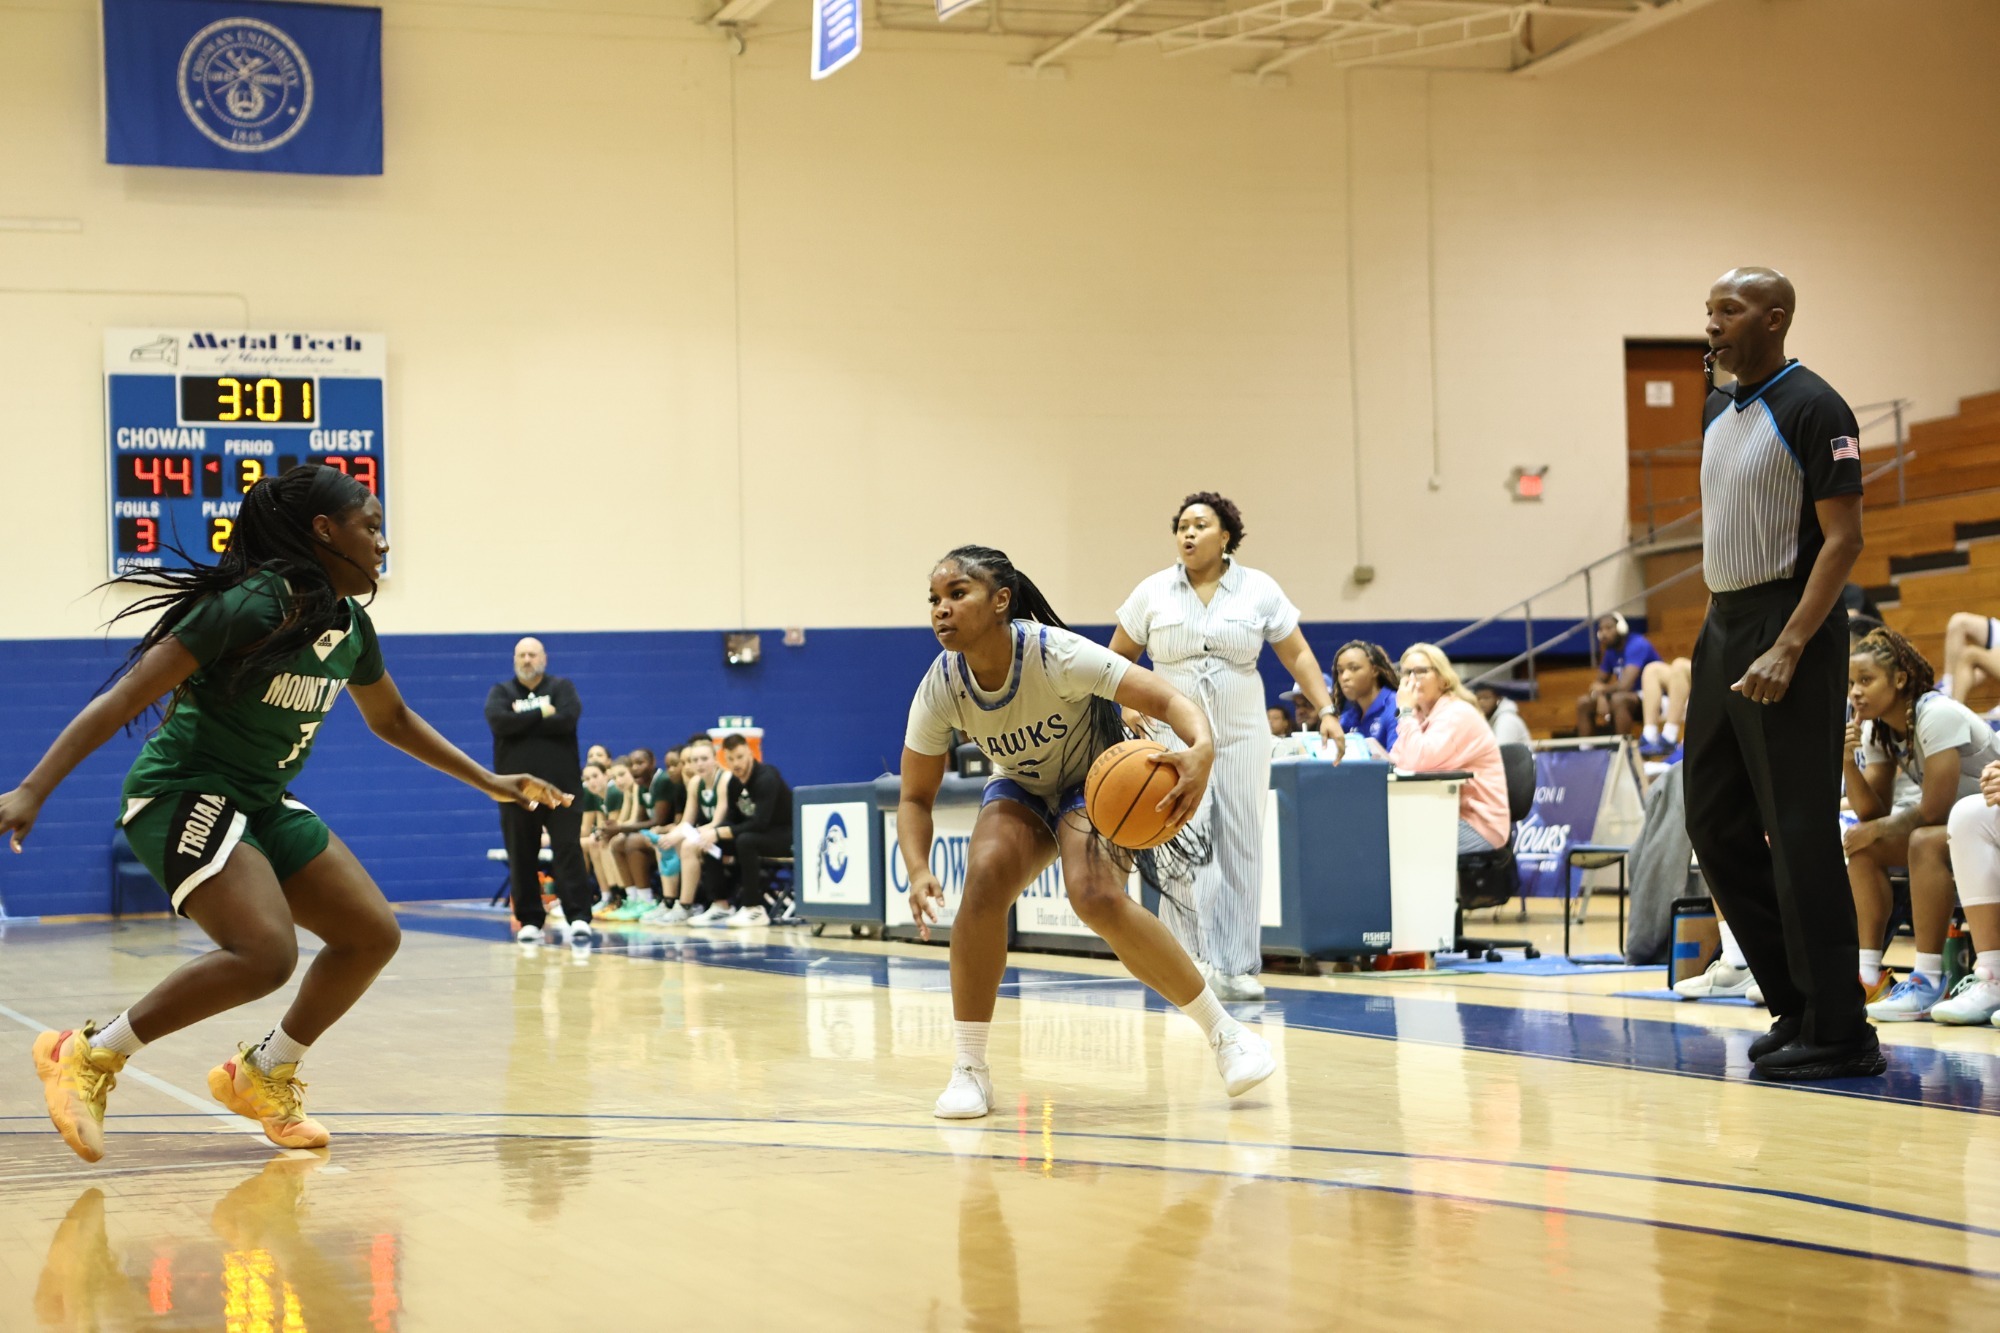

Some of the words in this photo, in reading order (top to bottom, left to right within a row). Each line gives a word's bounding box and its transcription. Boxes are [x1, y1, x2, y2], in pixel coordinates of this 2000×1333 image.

[187, 331, 277, 351] Metal
[284, 332, 363, 352] Tech
[217, 377, 312, 422] 3:01
[116, 427, 206, 450] CHOWAN
[224, 439, 274, 456] PERIOD
[309, 429, 374, 451] GUEST
[134, 457, 192, 495] 44
[241, 459, 263, 494] 3
[115, 501, 160, 518] FOULS
[136, 518, 158, 553] 3
[261, 672, 328, 712] MOUNT
[1036, 907, 1059, 926] Home
[1059, 906, 1068, 926] of
[1363, 931, 1391, 943] FISHER
